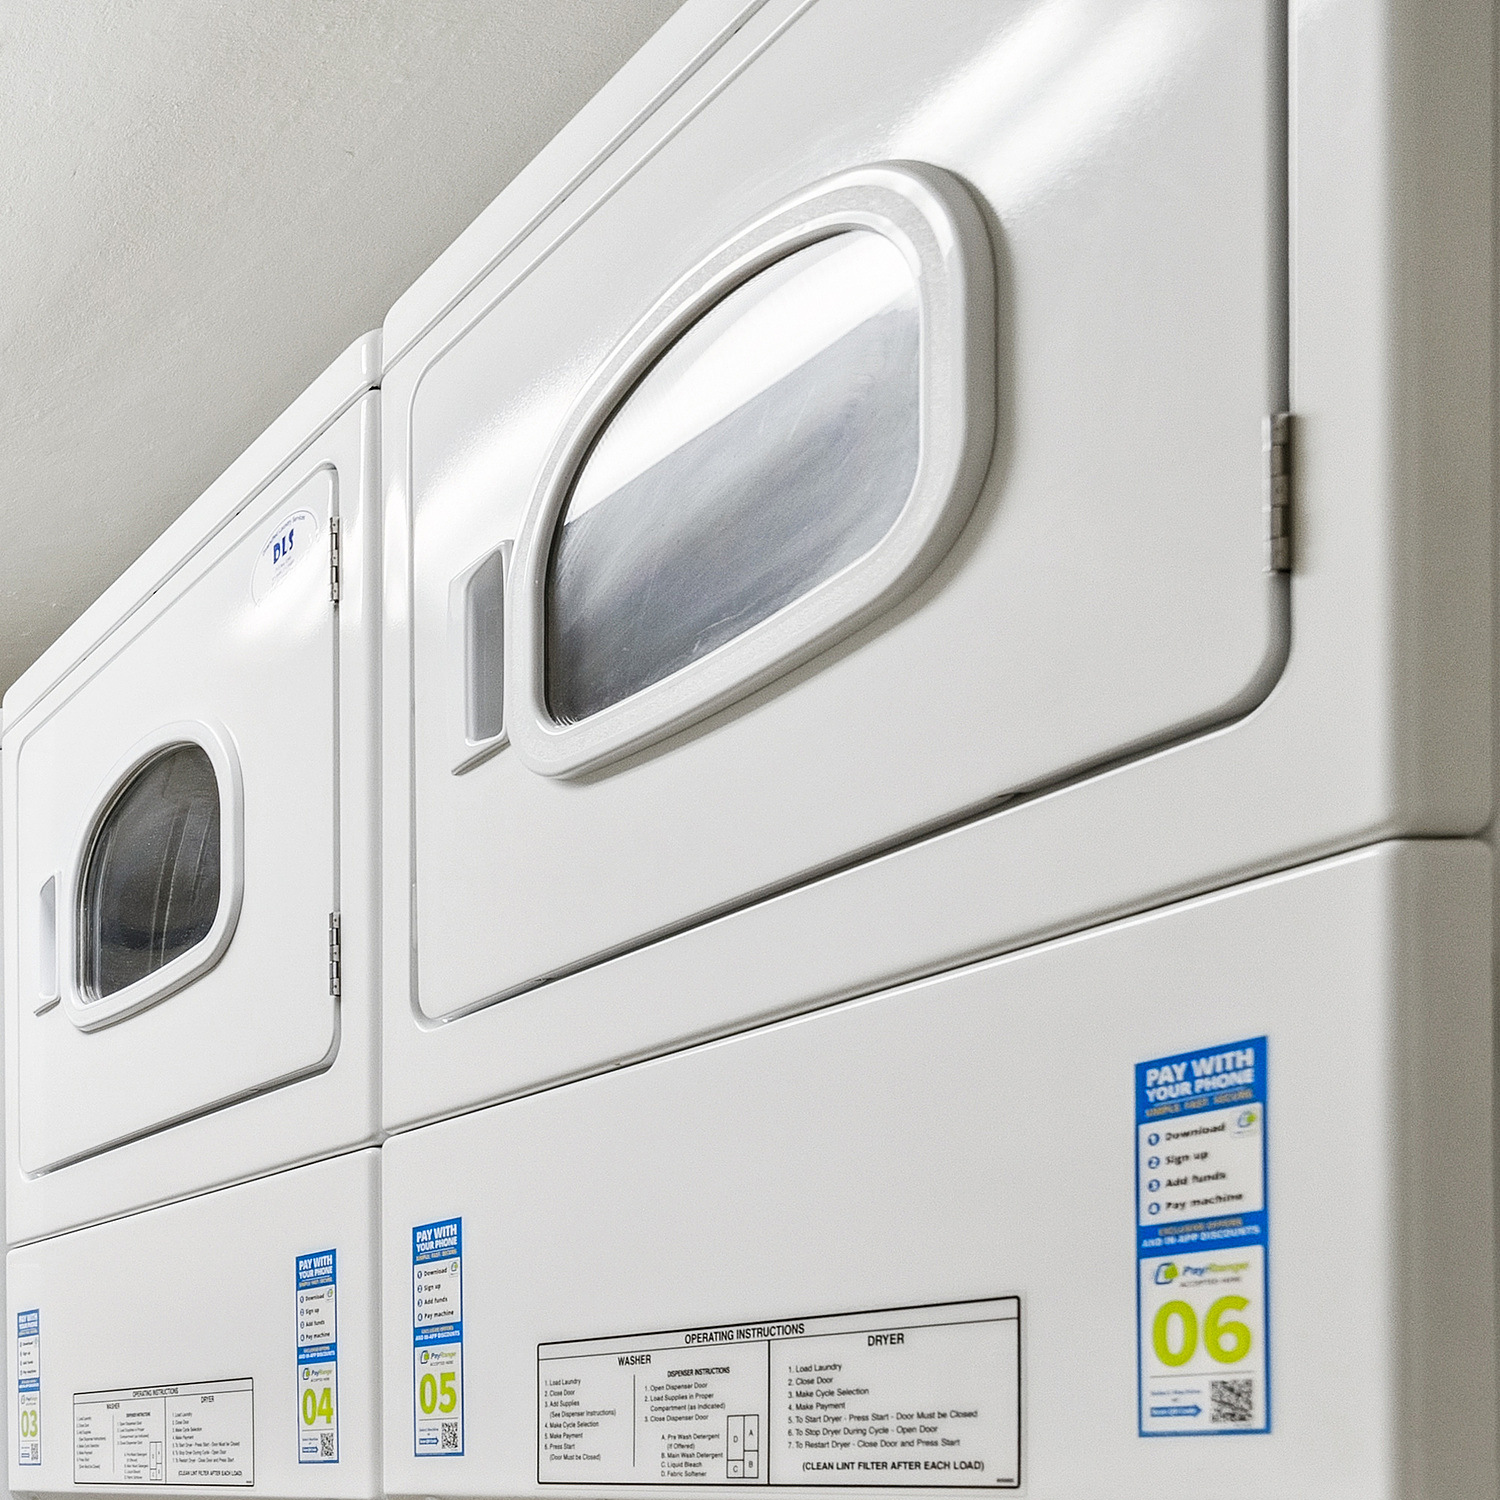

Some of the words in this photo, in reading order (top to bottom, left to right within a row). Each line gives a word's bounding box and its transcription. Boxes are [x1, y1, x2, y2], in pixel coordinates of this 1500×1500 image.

[1146, 1061, 1188, 1088] PAY
[1191, 1047, 1255, 1077] WITH
[1145, 1081, 1192, 1102] YOUR
[1194, 1067, 1255, 1093] PHONE
[1165, 1122, 1226, 1141] Download
[1165, 1155, 1190, 1165] Sign
[1193, 1151, 1209, 1161] up
[1165, 1176, 1187, 1187] Add
[1192, 1171, 1226, 1184] funds
[1165, 1200, 1186, 1211] Pay
[1190, 1192, 1243, 1207] machine
[416, 1228, 433, 1243] PAY
[433, 1223, 457, 1239] WITH
[416, 1240, 435, 1253] YOUR
[435, 1236, 458, 1249] PHONE
[299, 1258, 313, 1270] PAY
[313, 1254, 333, 1268] WITH
[299, 1269, 314, 1280] YOUR
[314, 1265, 333, 1277] PHONE
[424, 1267, 447, 1277] Download
[433, 1310, 454, 1318] machine
[684, 1330, 734, 1345] OPERATING
[736, 1323, 805, 1341] INSTRUCTIONS
[1152, 1294, 1252, 1368] 06
[867, 1332, 905, 1347] DRYER
[617, 1354, 652, 1367] WASHER
[795, 1364, 813, 1373] Load
[814, 1363, 843, 1372] Laundry
[667, 1368, 694, 1378] DISPENSER
[694, 1366, 730, 1376] INSTRUCTIONS
[795, 1377, 815, 1386] Close
[816, 1376, 834, 1385] Door
[419, 1372, 457, 1415] 05
[795, 1390, 814, 1398] Make
[815, 1389, 835, 1399] Cycle
[836, 1388, 869, 1396] Selection
[302, 1387, 333, 1426] 04
[795, 1403, 814, 1411] Make
[816, 1402, 846, 1412] Payment
[20, 1410, 38, 1437] 03
[795, 1416, 803, 1424] To
[805, 1415, 821, 1423] Start
[823, 1415, 842, 1424] Dryer
[849, 1413, 869, 1422] Press
[871, 1413, 889, 1421] Start
[896, 1412, 914, 1420] Door
[916, 1411, 935, 1419] Must
[937, 1411, 947, 1419] be
[949, 1409, 978, 1419] Closed
[795, 1428, 803, 1436] To
[805, 1428, 821, 1437] Stop
[822, 1427, 841, 1437] Dryer
[843, 1427, 867, 1436] During
[868, 1426, 889, 1436] Cycle
[896, 1425, 917, 1435] Open
[919, 1425, 938, 1433] Door
[795, 1441, 803, 1449] To
[805, 1440, 830, 1449] Restart
[831, 1440, 851, 1450] Dryer
[857, 1440, 878, 1448] Close
[880, 1439, 898, 1448] Door
[900, 1439, 915, 1447] and
[916, 1439, 938, 1447] Press
[941, 1438, 961, 1447] Start
[802, 1461, 834, 1472] (CLEAN
[836, 1462, 855, 1471] LINT
[858, 1462, 888, 1471] FILTER
[890, 1461, 921, 1470] AFTER
[924, 1461, 950, 1470] EACH
[953, 1460, 985, 1472] LOAD)
